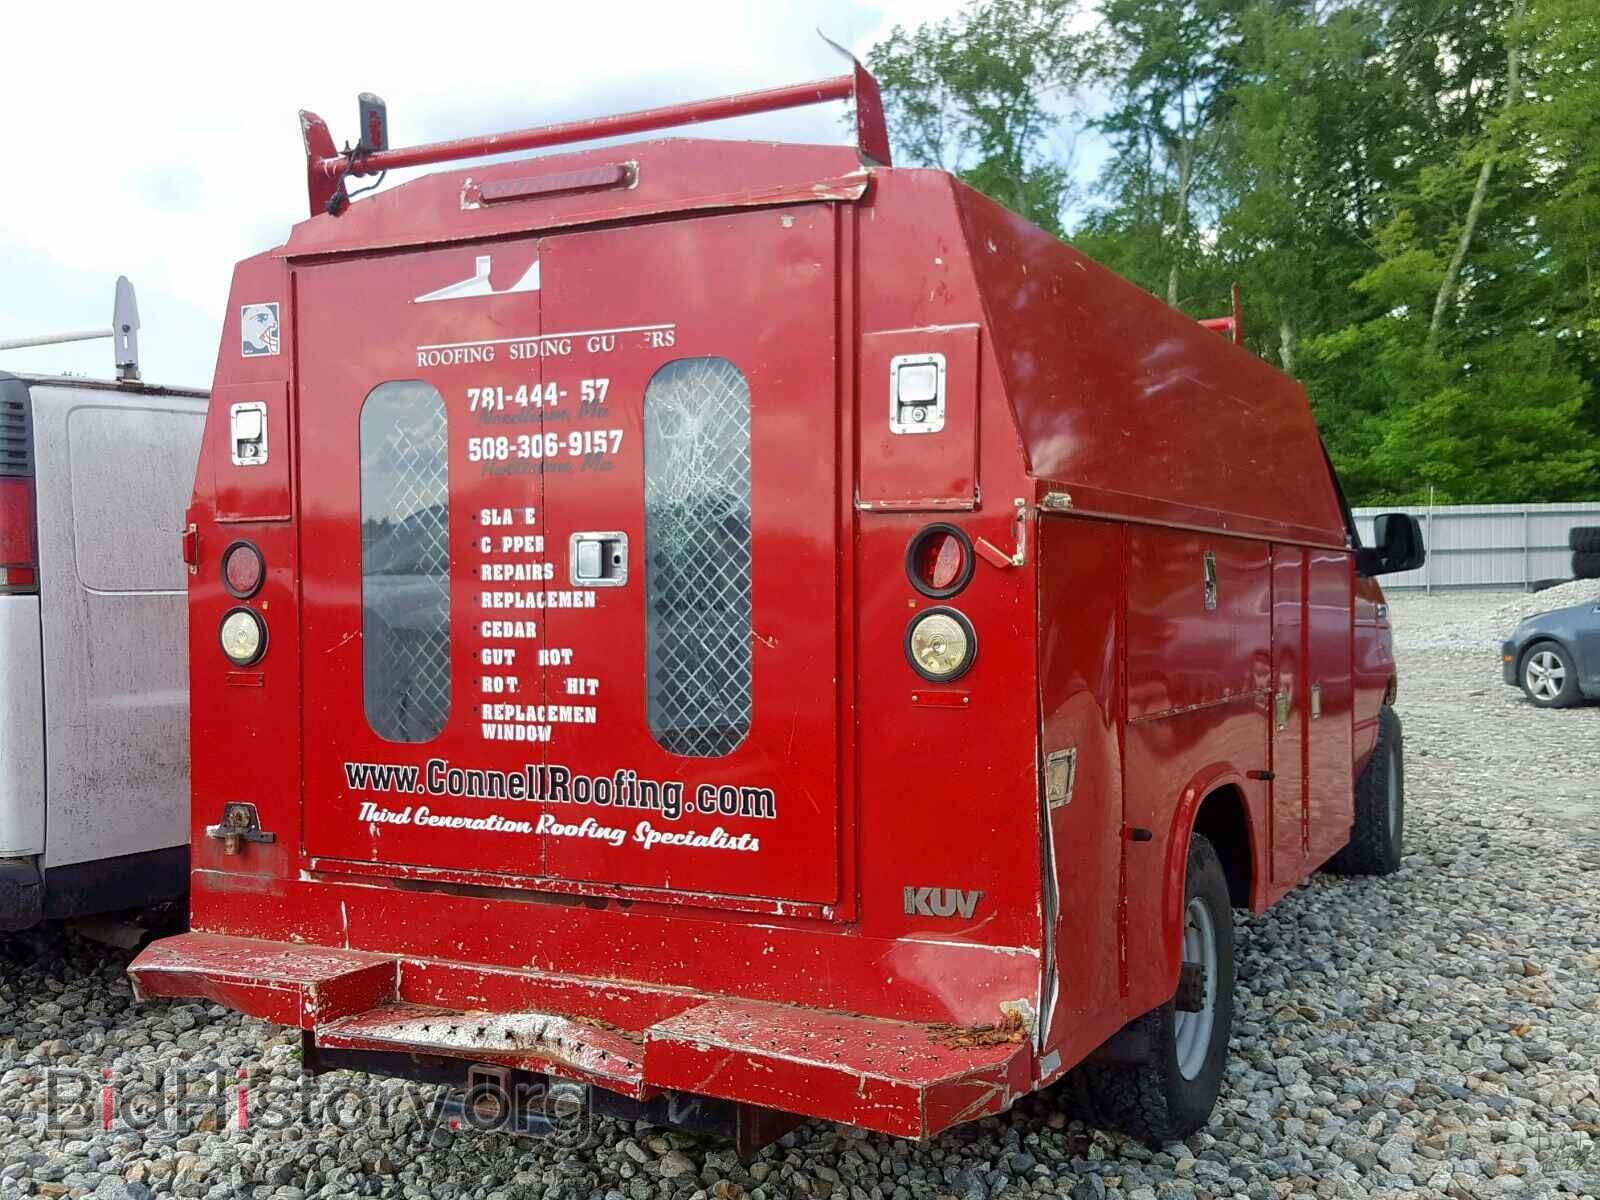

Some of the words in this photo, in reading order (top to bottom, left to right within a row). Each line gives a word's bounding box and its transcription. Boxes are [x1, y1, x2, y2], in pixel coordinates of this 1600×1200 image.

[417, 345, 495, 367] ROOFING
[509, 338, 572, 360] SIDING
[468, 429, 623, 461] 508-306-9157
[480, 563, 554, 581] REPAIRS
[481, 590, 596, 608] REPLACEMEN
[481, 621, 537, 638] CEDAR
[482, 648, 516, 665] GUT
[538, 648, 573, 666] ROT
[481, 676, 518, 693] ROT
[482, 703, 597, 723] REPLACEMEN
[482, 723, 552, 742] WINDOW
[344, 758, 777, 820] www.ConnellRoofing.com
[358, 802, 412, 825] Third
[414, 806, 533, 834] Generation
[536, 814, 627, 847] Roofing
[632, 820, 760, 853] Specialists
[904, 886, 982, 918] KUV
